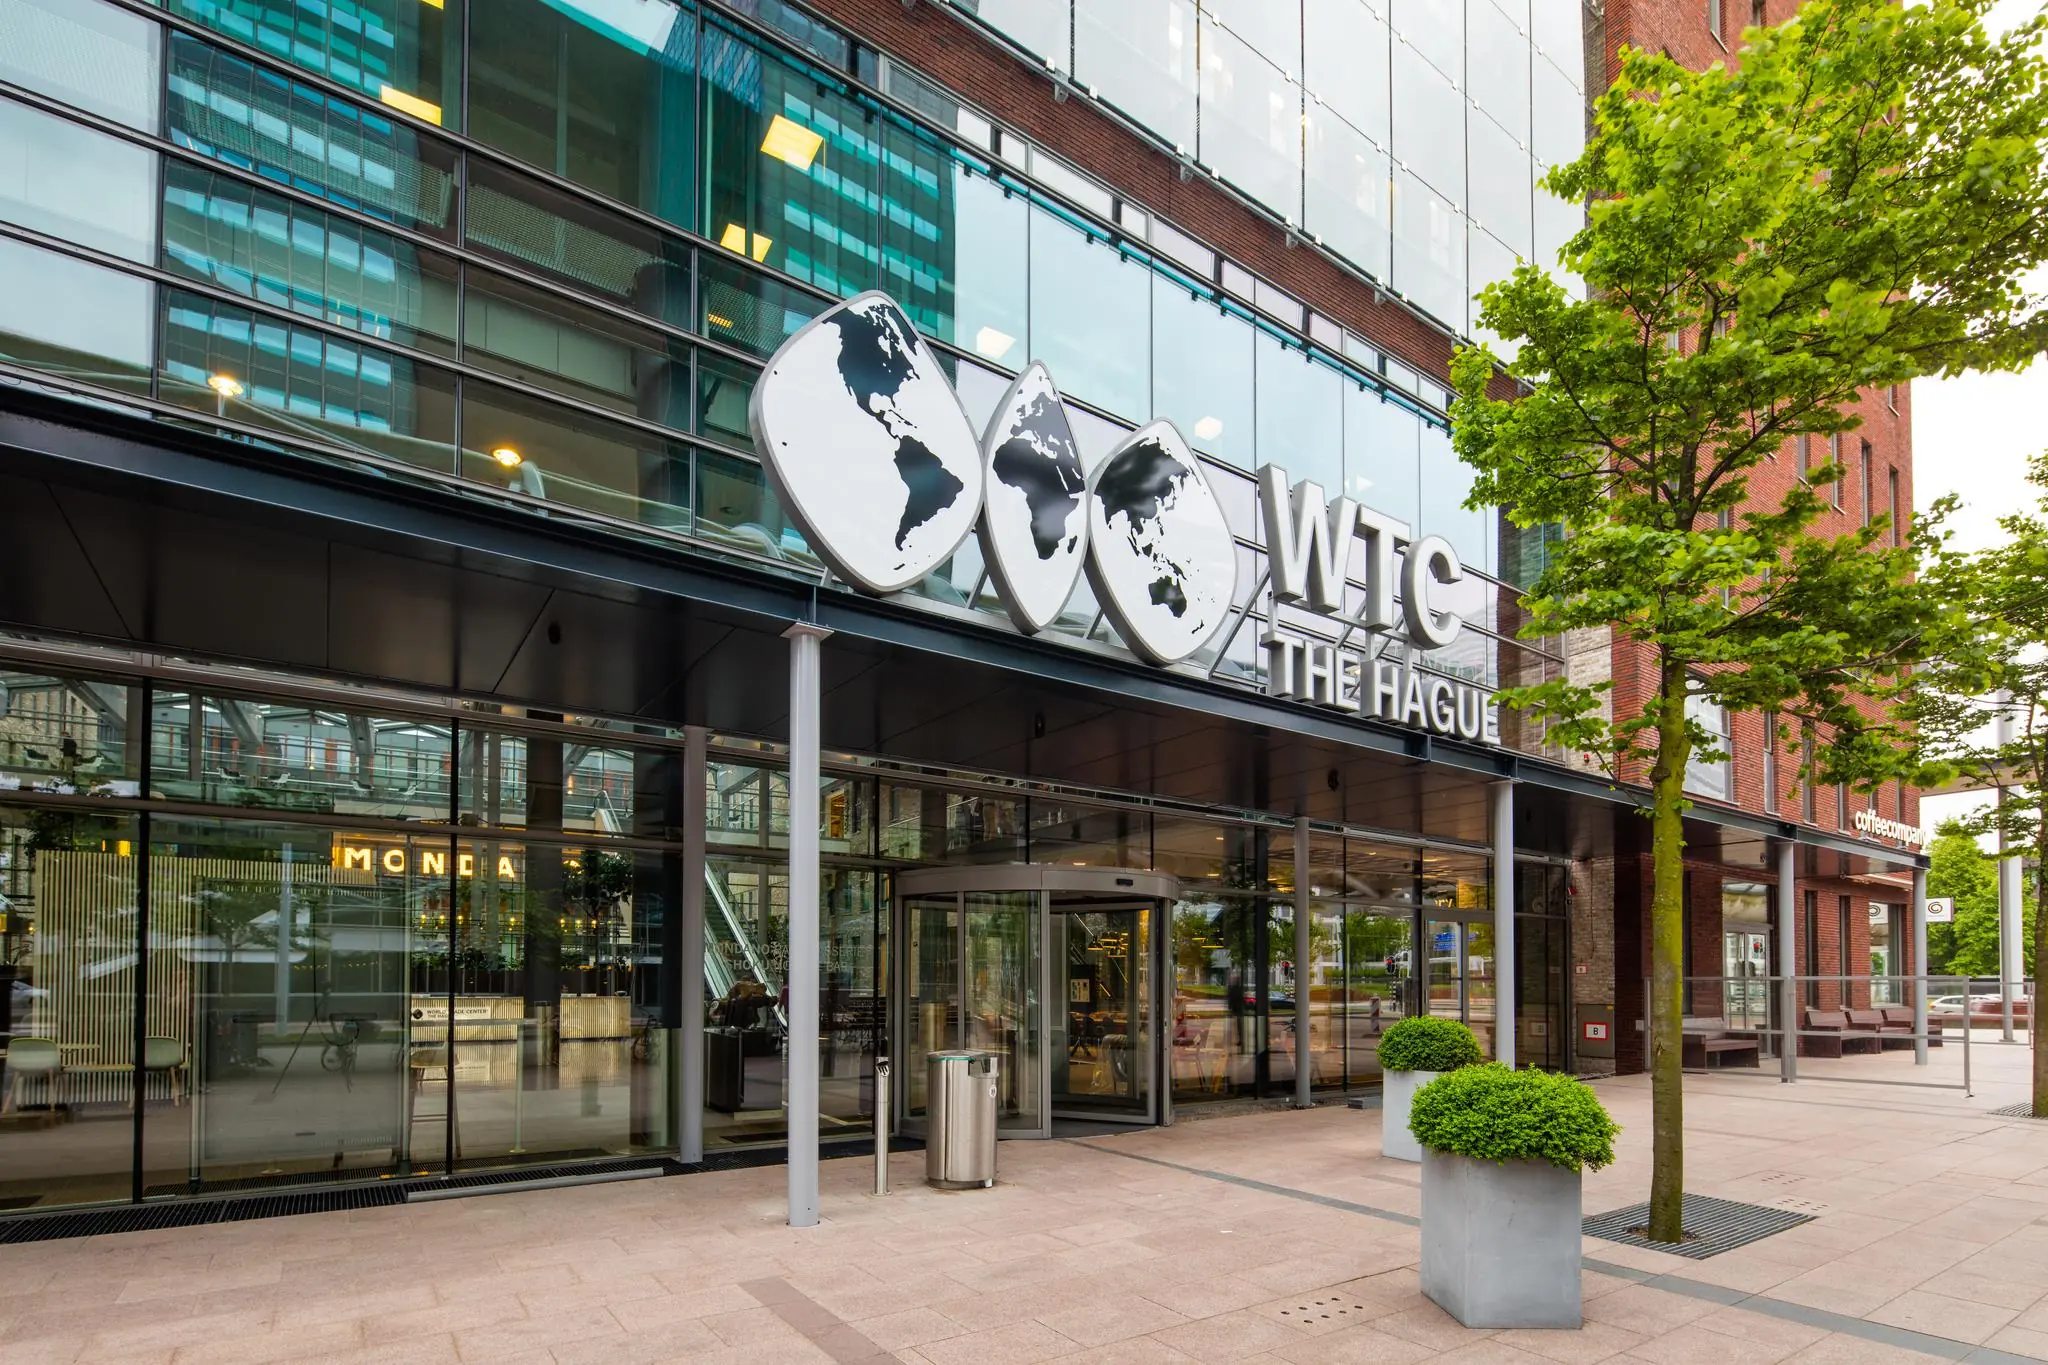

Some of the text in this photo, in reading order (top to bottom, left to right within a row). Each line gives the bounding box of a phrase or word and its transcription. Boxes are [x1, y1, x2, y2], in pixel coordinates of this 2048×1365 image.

[1257, 463, 1463, 649] WTC
[1260, 630, 1501, 745] THE HAGUE
[1852, 808, 1927, 849] coffeecompany
[1593, 1027, 1599, 1035] B
